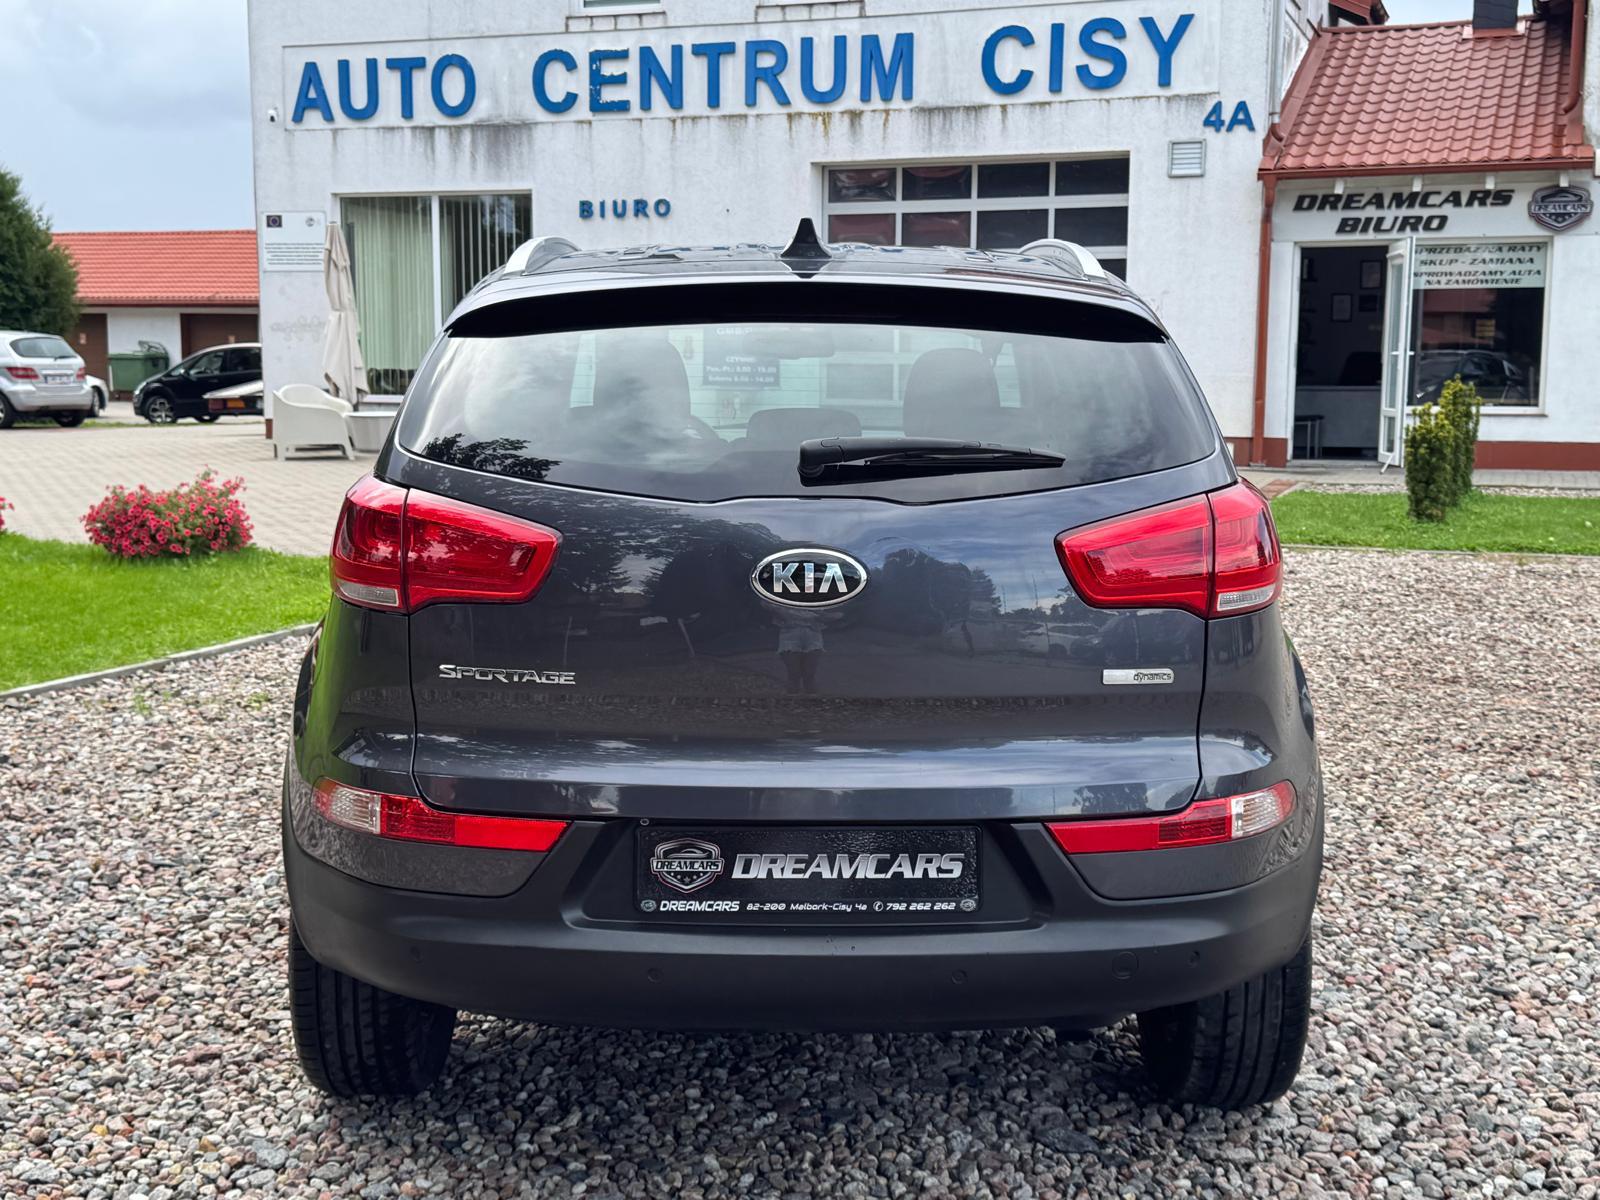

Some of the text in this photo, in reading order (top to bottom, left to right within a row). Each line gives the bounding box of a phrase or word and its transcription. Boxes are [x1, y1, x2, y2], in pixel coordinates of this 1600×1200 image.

[292, 13, 1195, 123] AUTO CENTRUM CISY
[1203, 100, 1256, 133] 4A
[579, 198, 671, 218] BIURO
[1292, 189, 1515, 212] DREAMCARS
[1335, 214, 1448, 234] BIURO
[1507, 245, 1545, 253] RATY
[1419, 259, 1460, 267] SKUP
[1469, 257, 1534, 266] ZAMIANA
[1507, 269, 1542, 277] AUTA
[772, 562, 848, 593] KIA
[439, 664, 576, 685] SPORTAGE
[655, 860, 721, 870] DREAMCARS
[731, 853, 965, 879] DREAMCARS
[659, 900, 740, 912] DREAMCARS
[746, 902, 786, 911] 82-200
[886, 902, 907, 911] 792
[909, 902, 932, 911] 262
[933, 902, 956, 911] 262
